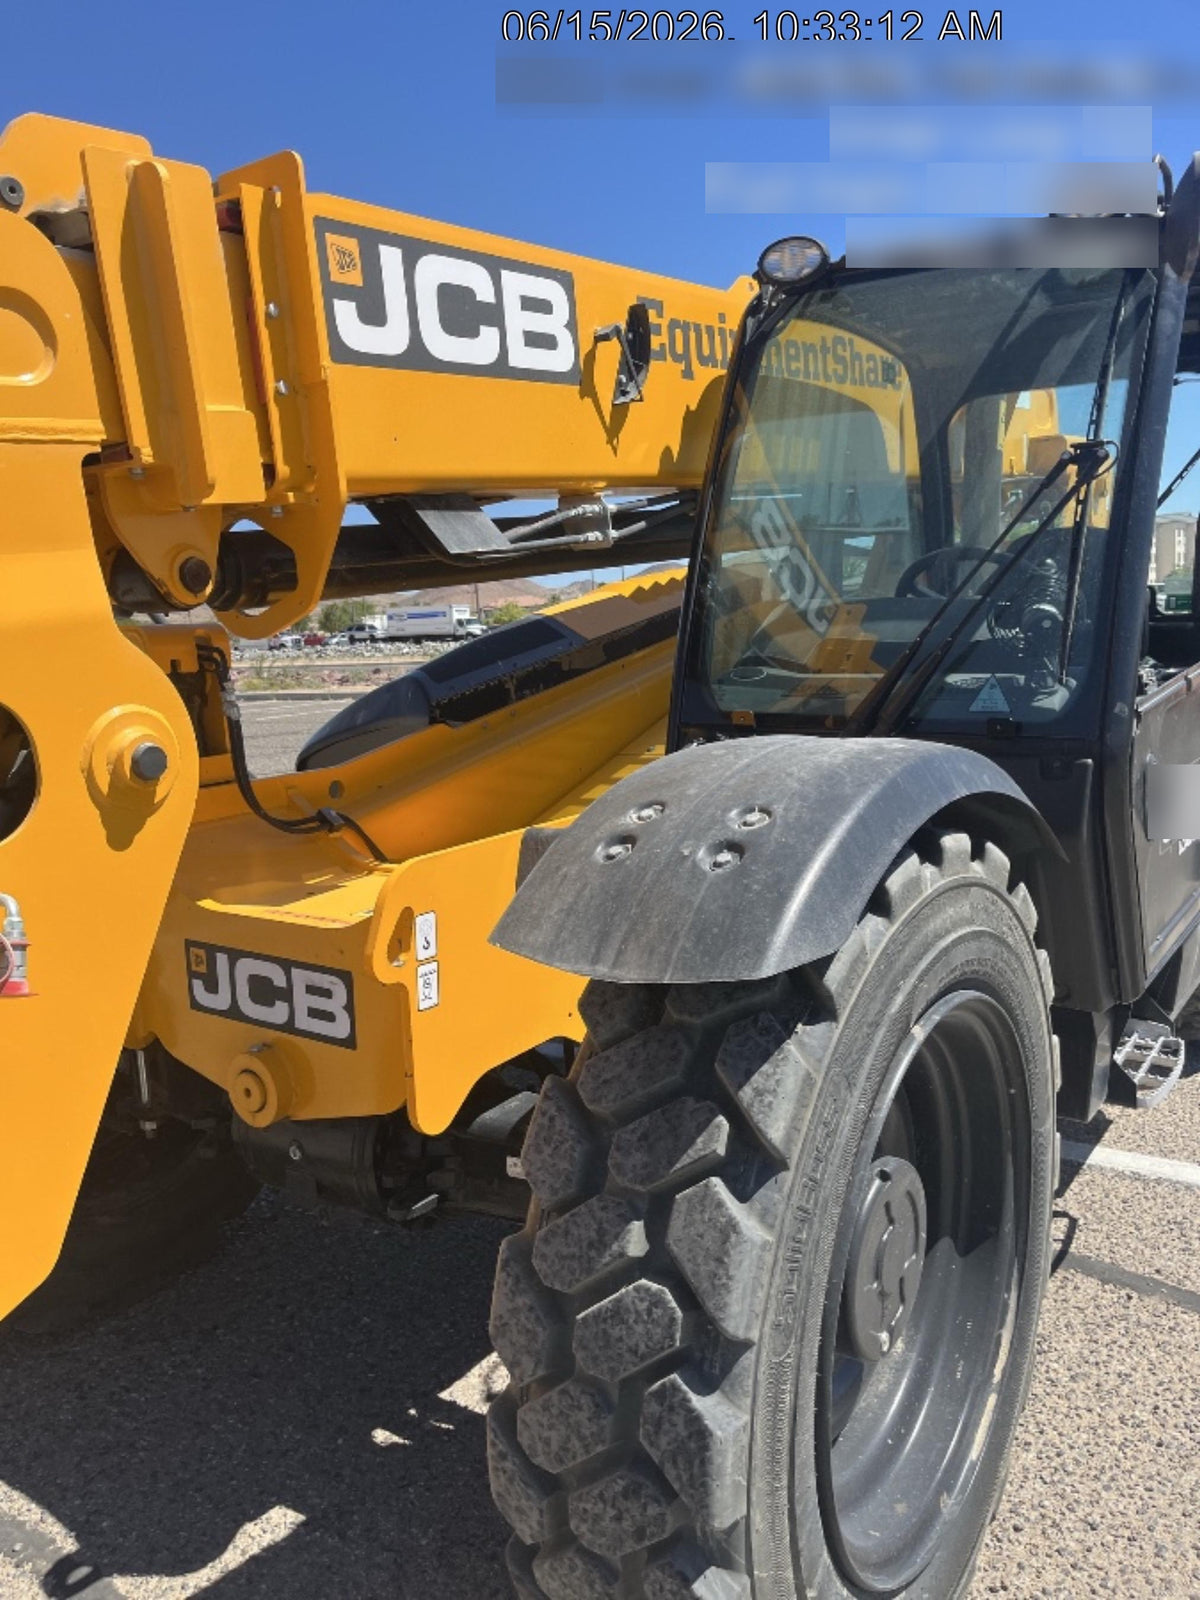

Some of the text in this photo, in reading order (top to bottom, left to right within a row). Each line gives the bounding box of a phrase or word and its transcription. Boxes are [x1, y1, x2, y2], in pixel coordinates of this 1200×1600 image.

[333, 243, 575, 372] JCB
[636, 295, 902, 391] EquimentShare
[192, 952, 351, 1040] JCB
